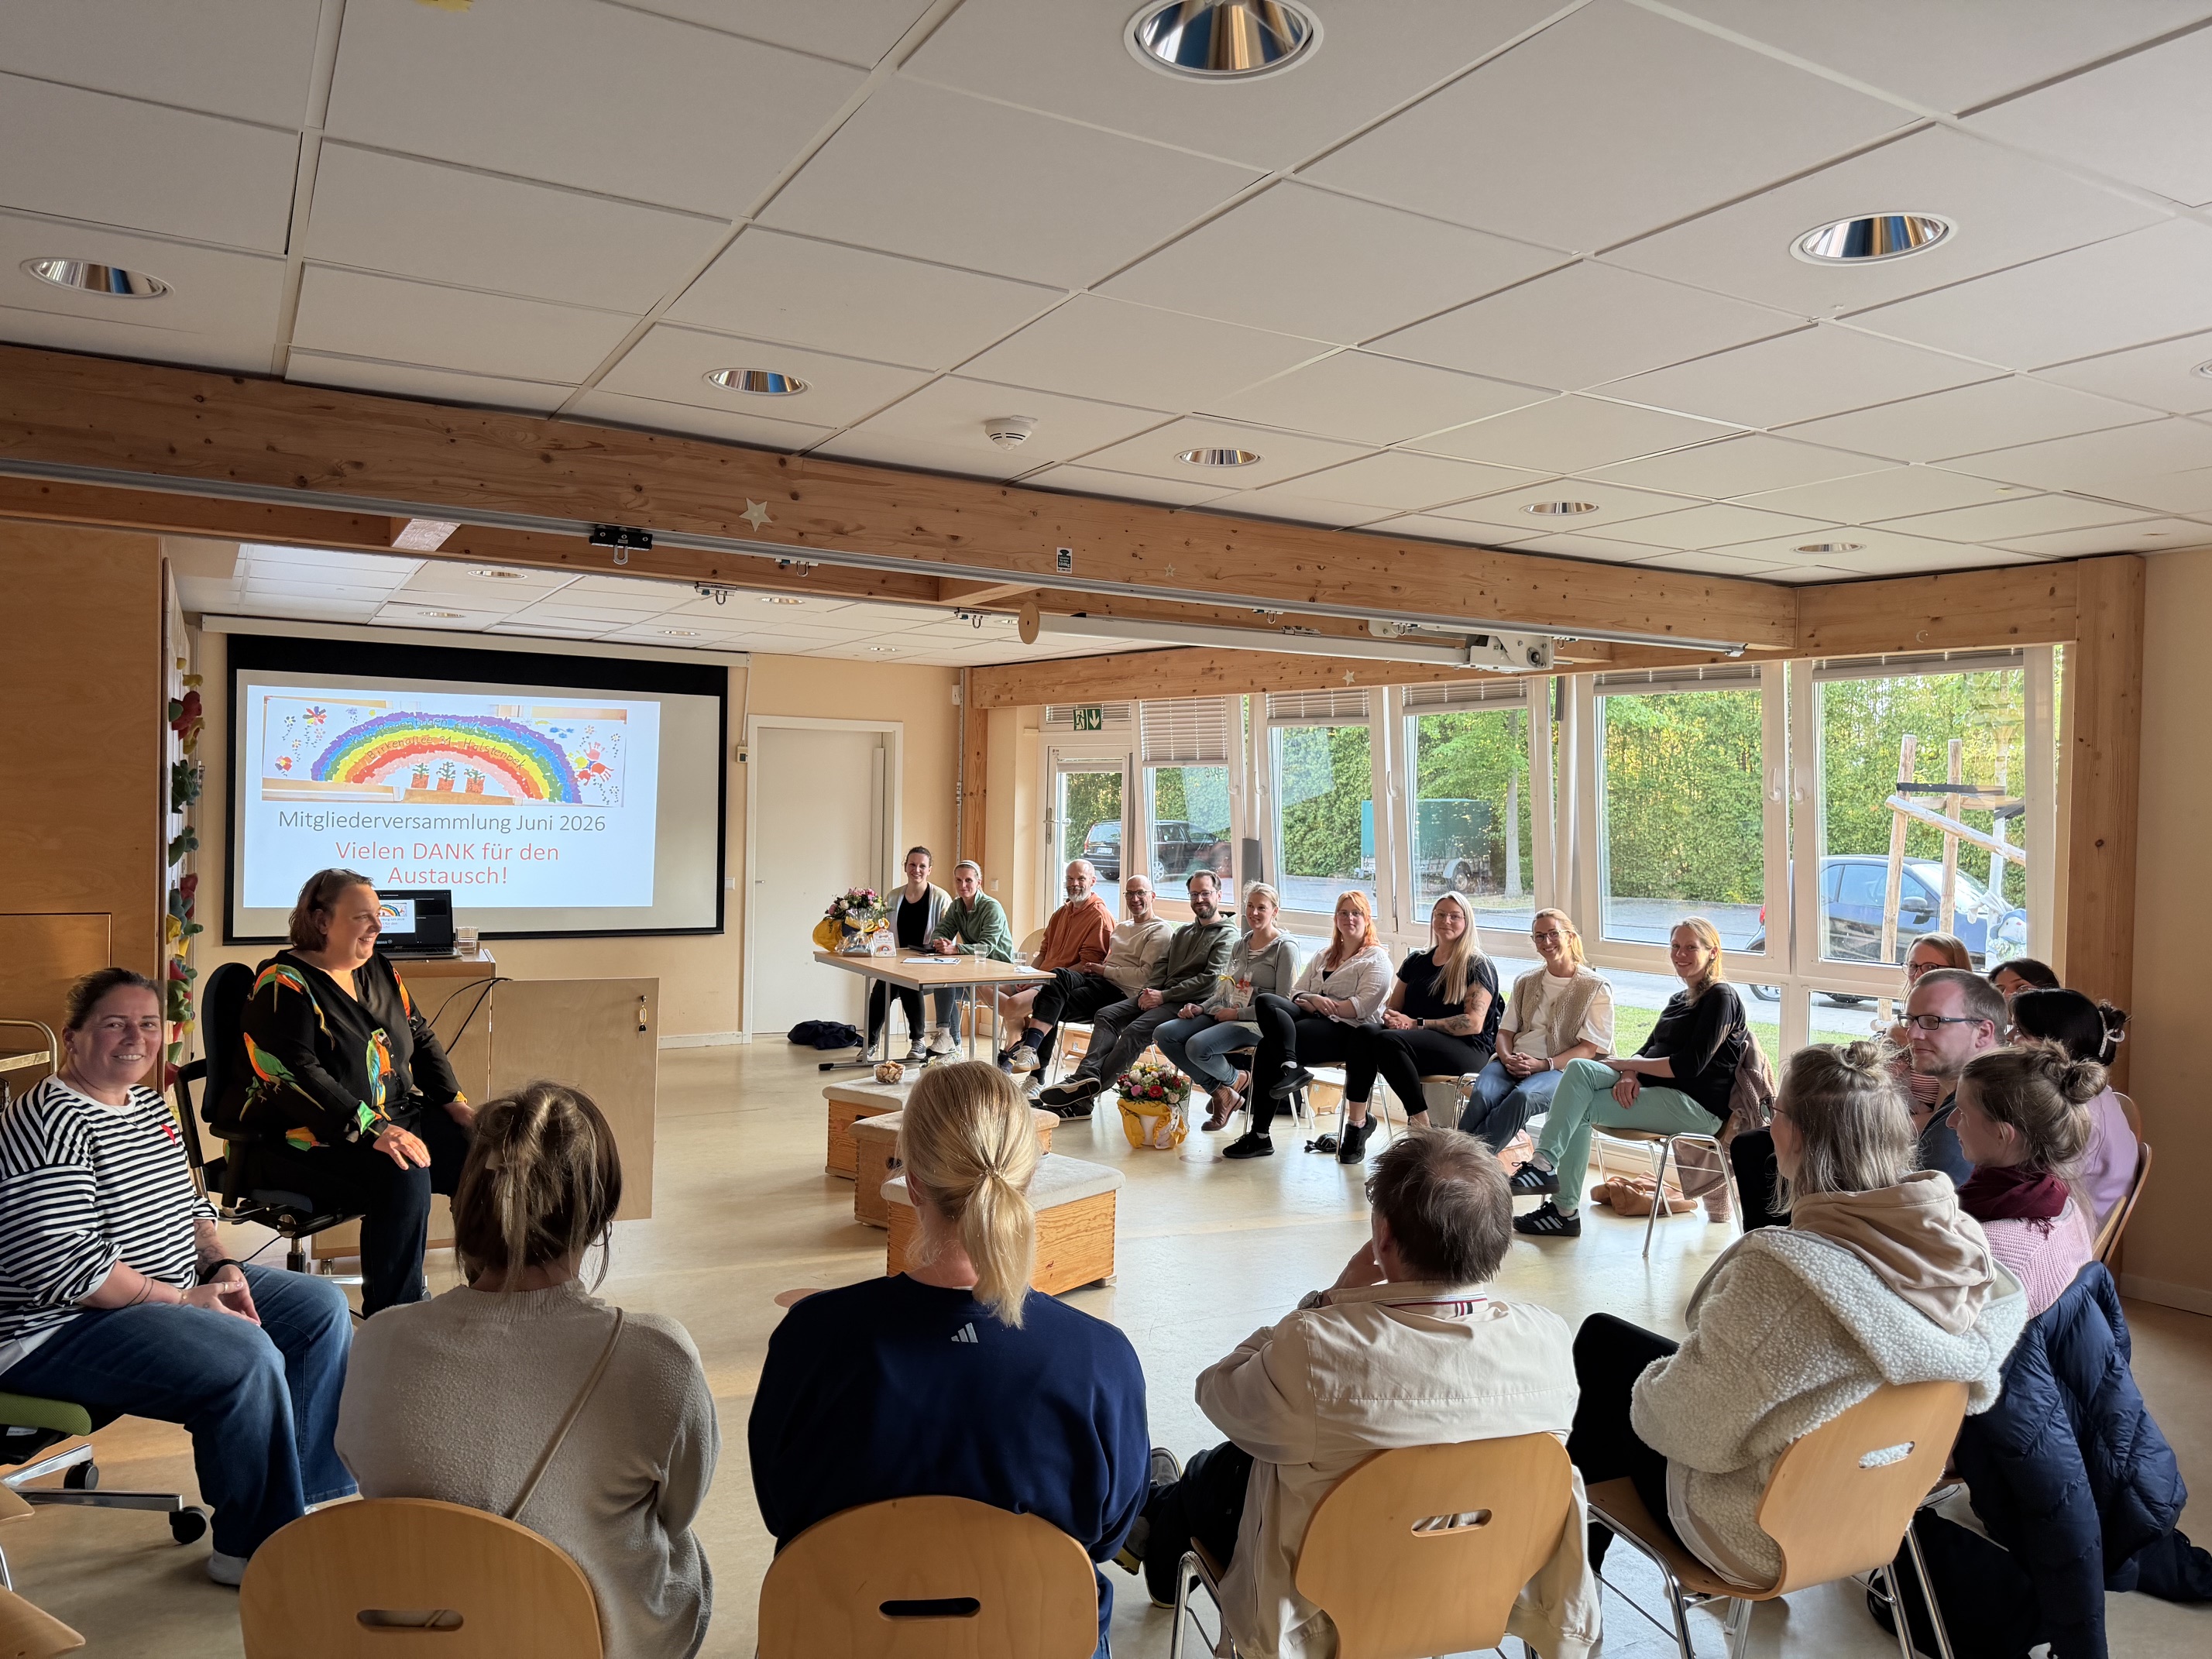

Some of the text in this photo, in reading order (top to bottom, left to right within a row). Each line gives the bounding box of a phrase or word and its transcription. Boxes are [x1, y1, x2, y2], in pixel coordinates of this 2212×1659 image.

[366, 736, 527, 770] Birkenallee 31 Halstenbek
[279, 811, 606, 834] Mitgliederversammlung Juni 2026
[335, 841, 559, 860] Vielen DANK für den
[387, 866, 507, 884] Austausch!
